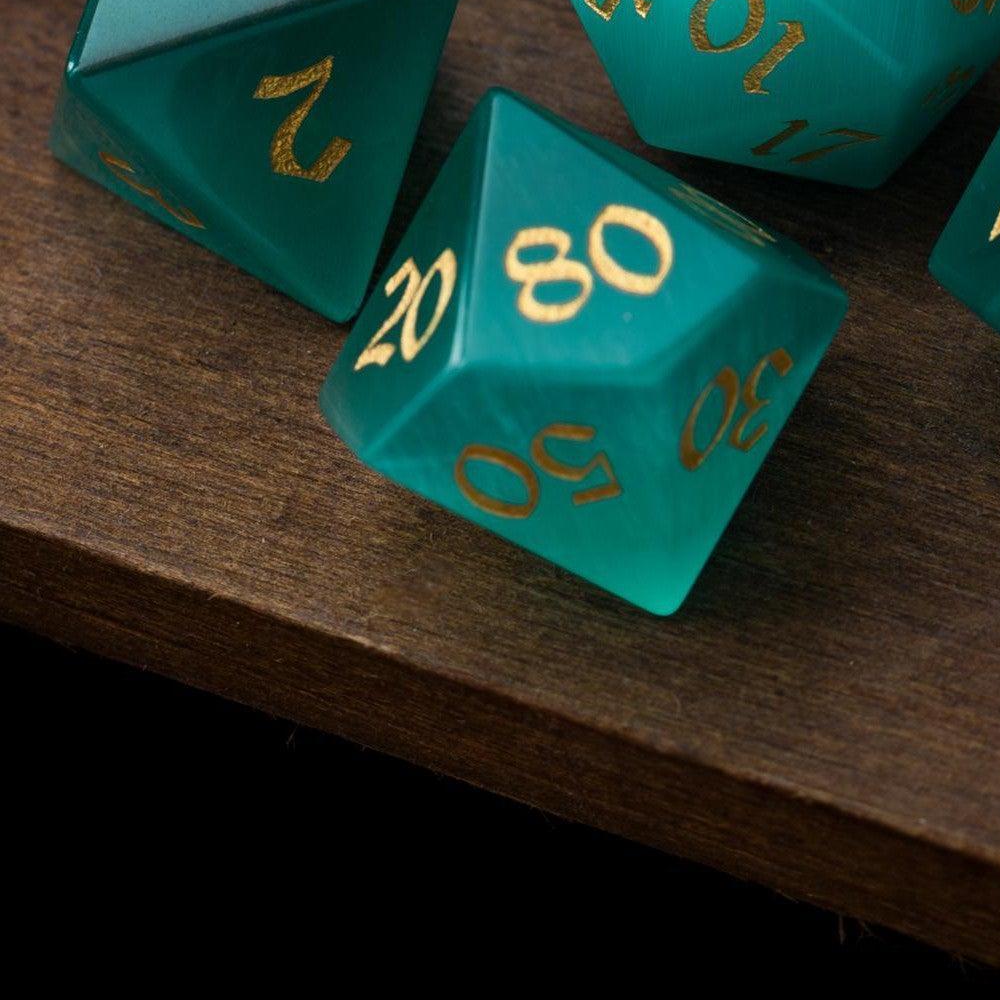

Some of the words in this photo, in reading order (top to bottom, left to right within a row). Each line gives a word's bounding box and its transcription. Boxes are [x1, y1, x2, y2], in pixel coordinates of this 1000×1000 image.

[252, 55, 353, 184] 2
[354, 247, 458, 373] 20
[504, 203, 675, 326] 80
[453, 421, 623, 520] 50
[680, 346, 795, 472] 30
